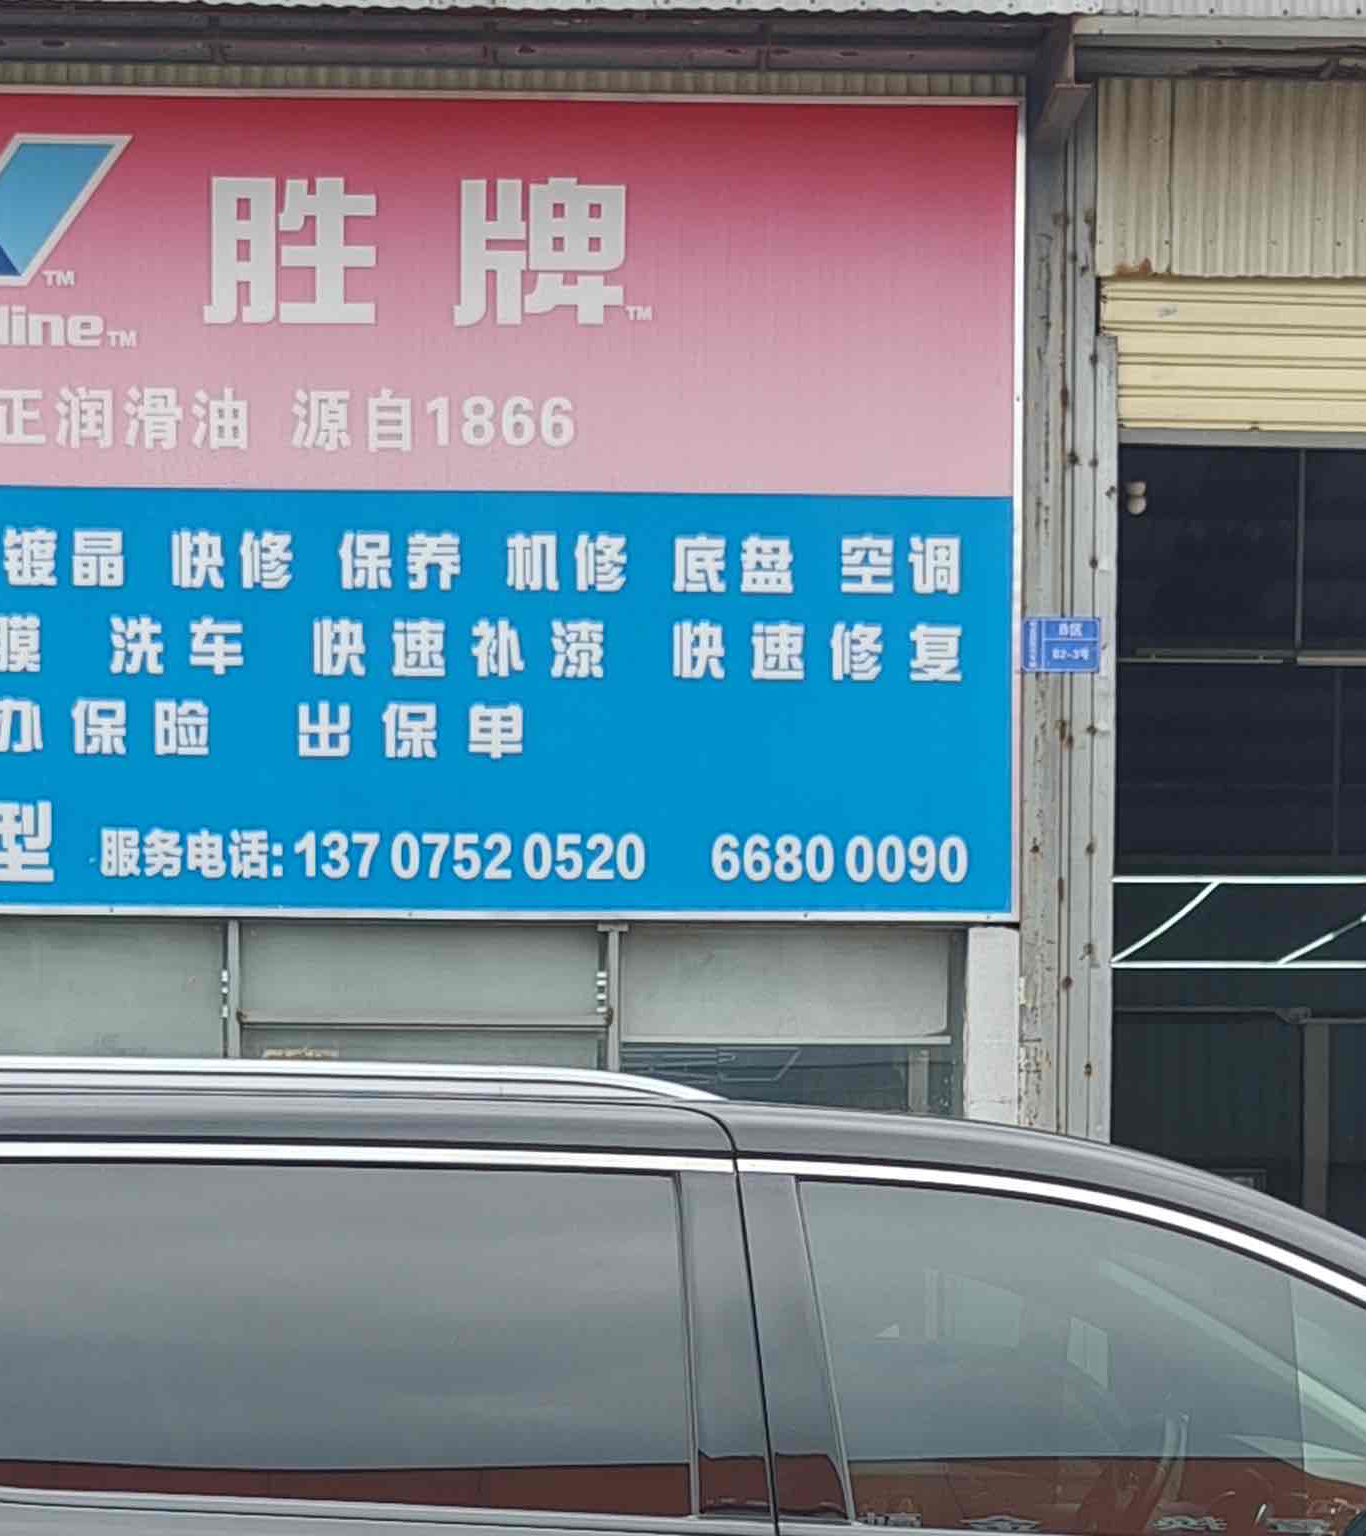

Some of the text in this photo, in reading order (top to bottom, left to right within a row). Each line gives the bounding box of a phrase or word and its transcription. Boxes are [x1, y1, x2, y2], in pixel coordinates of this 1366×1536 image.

[203, 176, 626, 327] 胜牌
[290, 387, 576, 452] 源自1866
[2, 528, 125, 588] 镀晶
[170, 530, 293, 590] 快修
[338, 531, 460, 591] 保养
[505, 532, 627, 593] 机修
[672, 534, 795, 594] 底盘
[840, 536, 961, 595] 空调
[109, 616, 244, 676] 洗车
[312, 618, 605, 679] 快速补漆
[672, 622, 963, 682] 快速修复
[297, 701, 524, 760] 出保单
